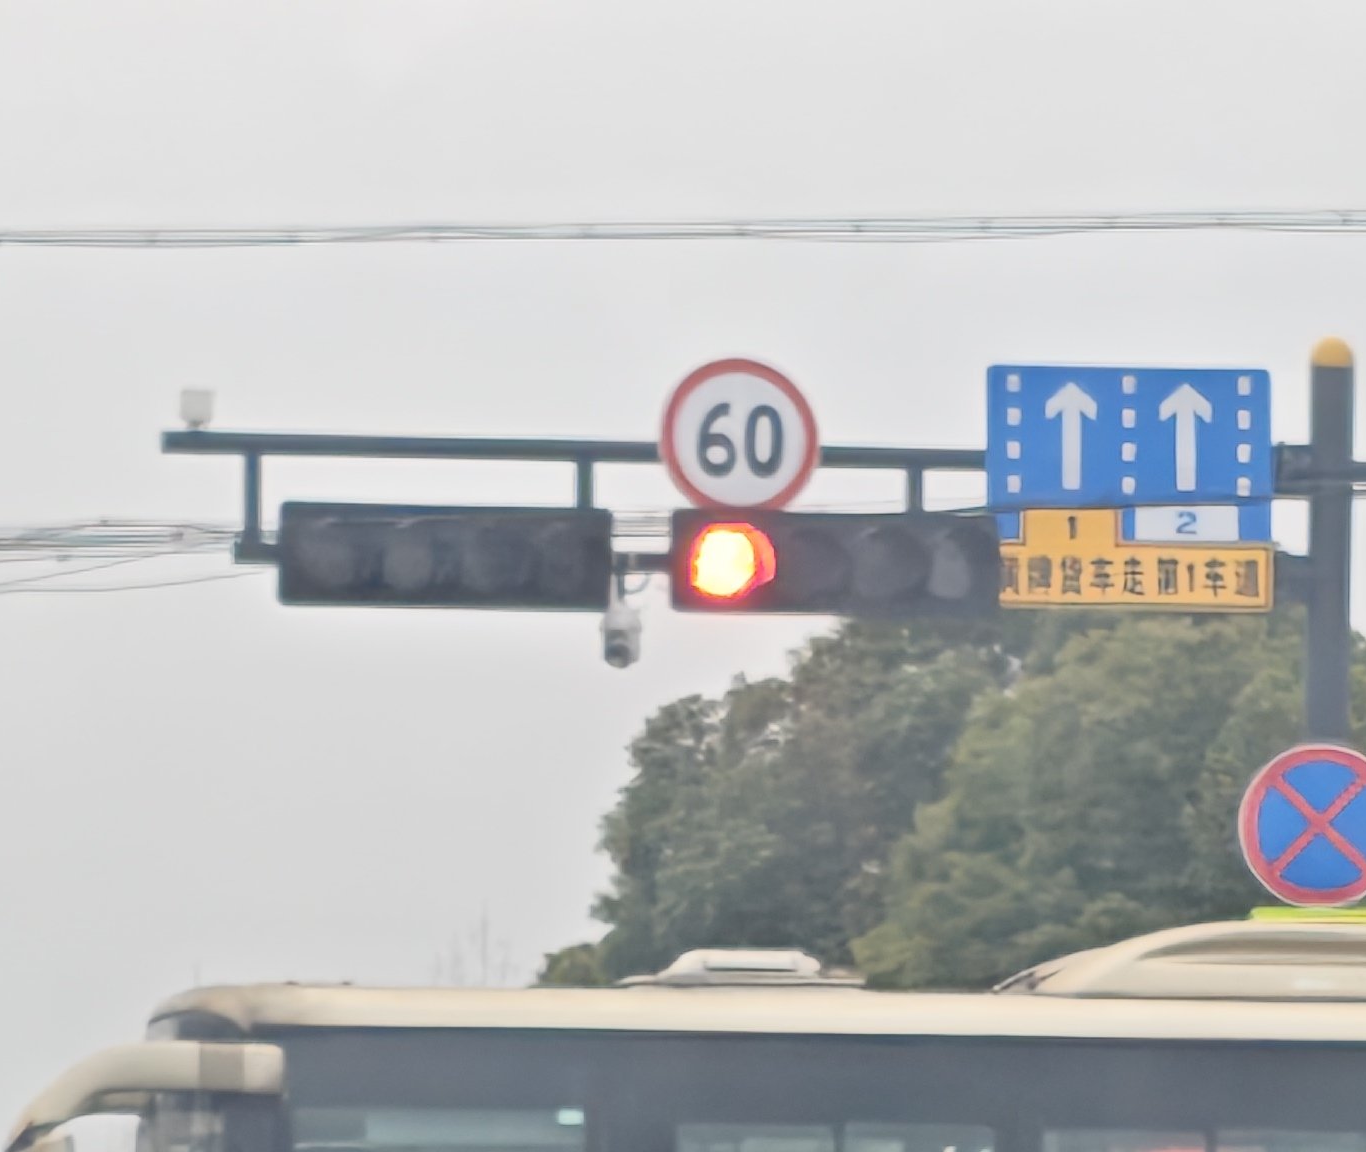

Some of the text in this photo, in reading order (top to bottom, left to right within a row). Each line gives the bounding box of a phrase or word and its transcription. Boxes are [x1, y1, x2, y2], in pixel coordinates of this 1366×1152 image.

[697, 402, 784, 479] 60
[1067, 515, 1078, 540] 1
[1175, 511, 1198, 535] 2
